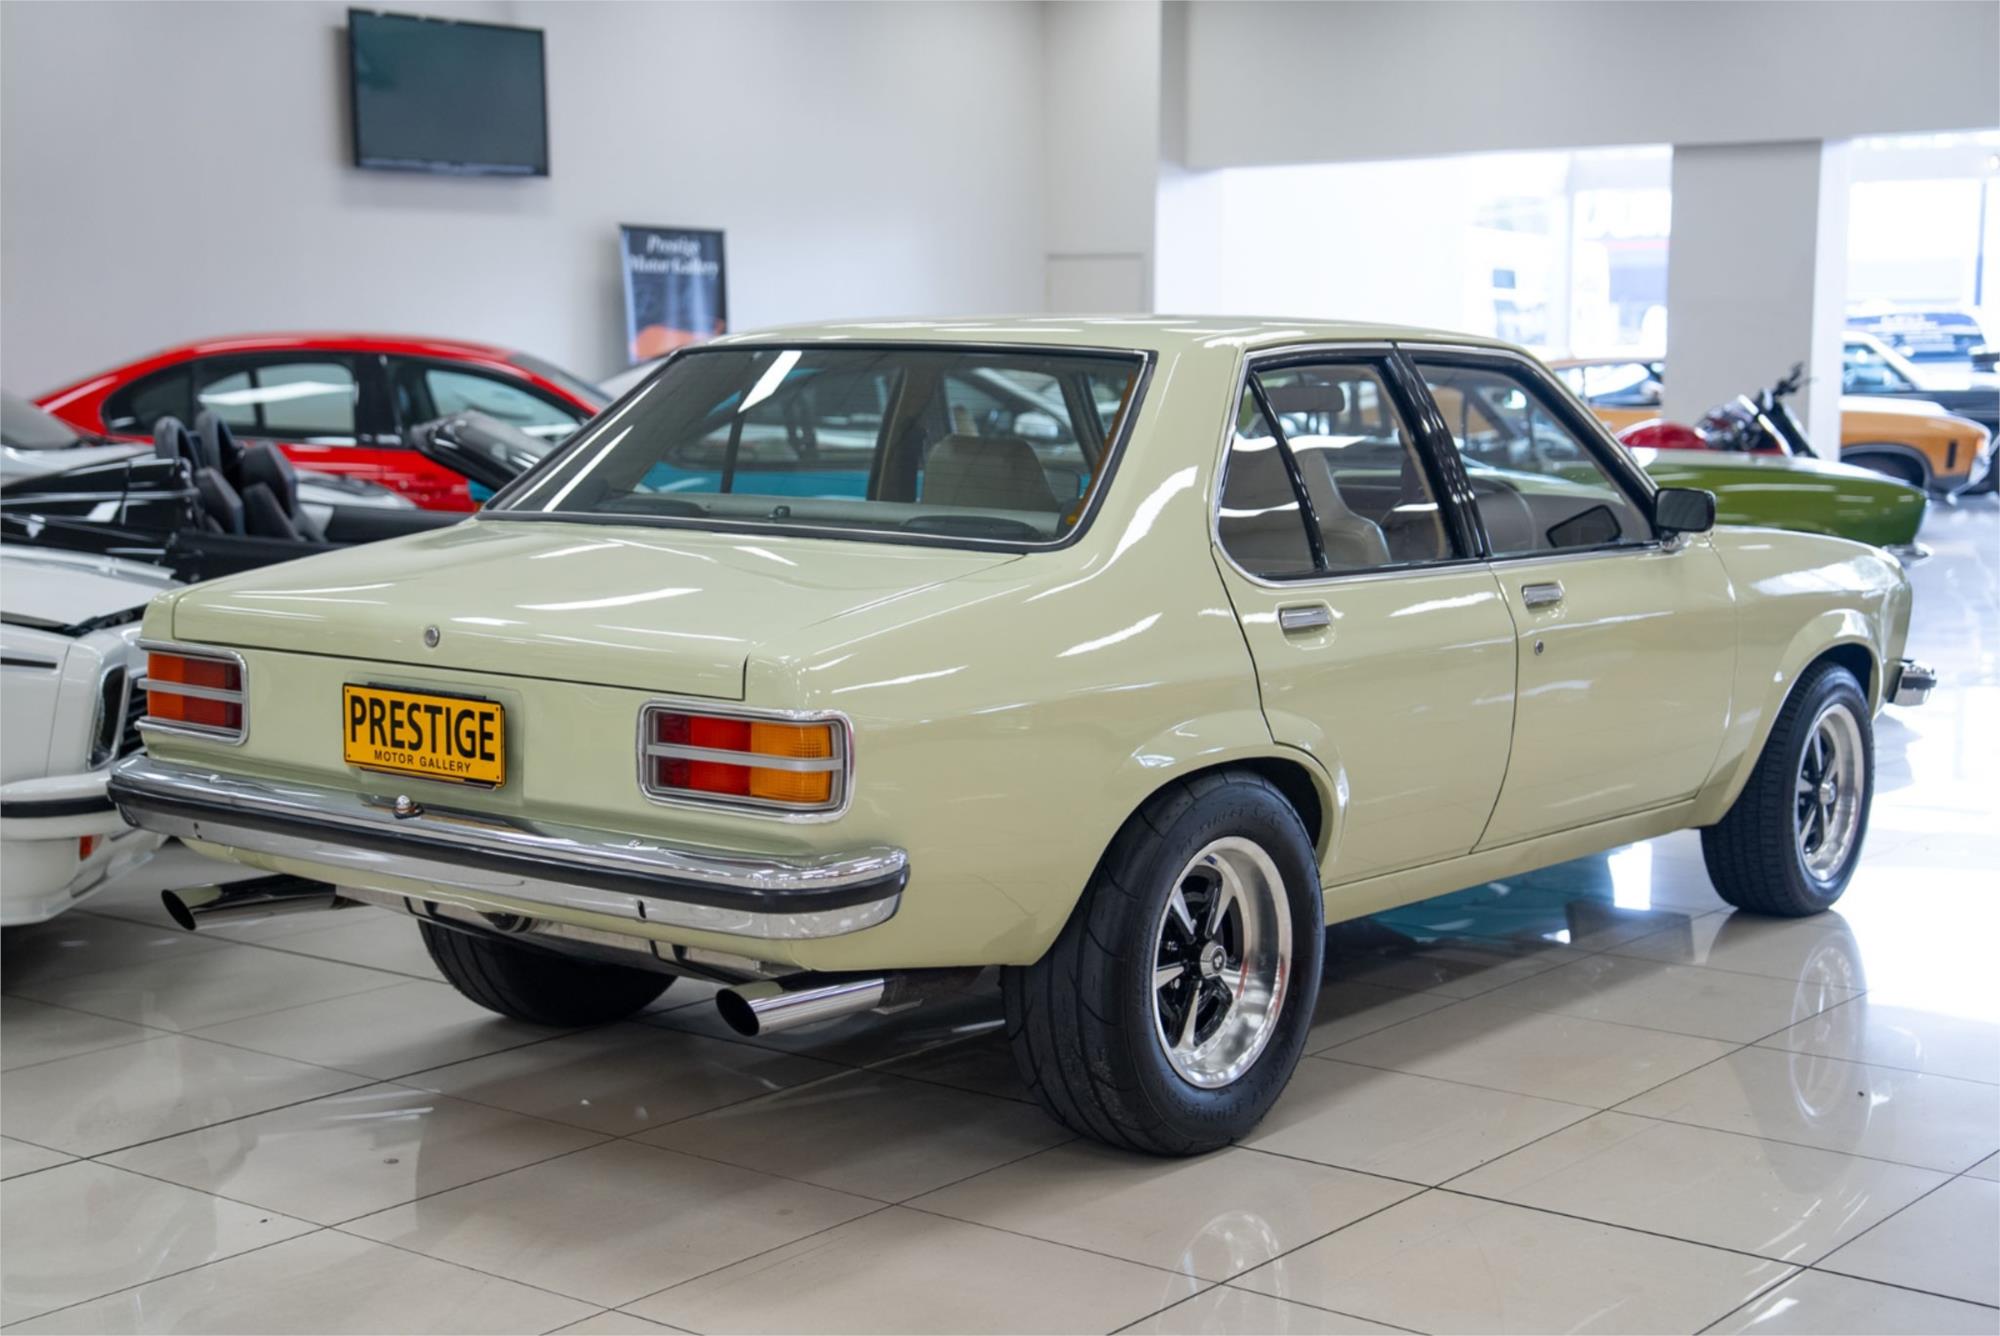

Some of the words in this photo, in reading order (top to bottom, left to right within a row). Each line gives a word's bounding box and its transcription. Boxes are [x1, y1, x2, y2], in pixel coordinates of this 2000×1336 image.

[350, 695, 495, 761] PRESTIGE
[374, 750, 414, 765] MOTOR
[419, 756, 472, 773] GALLERY
